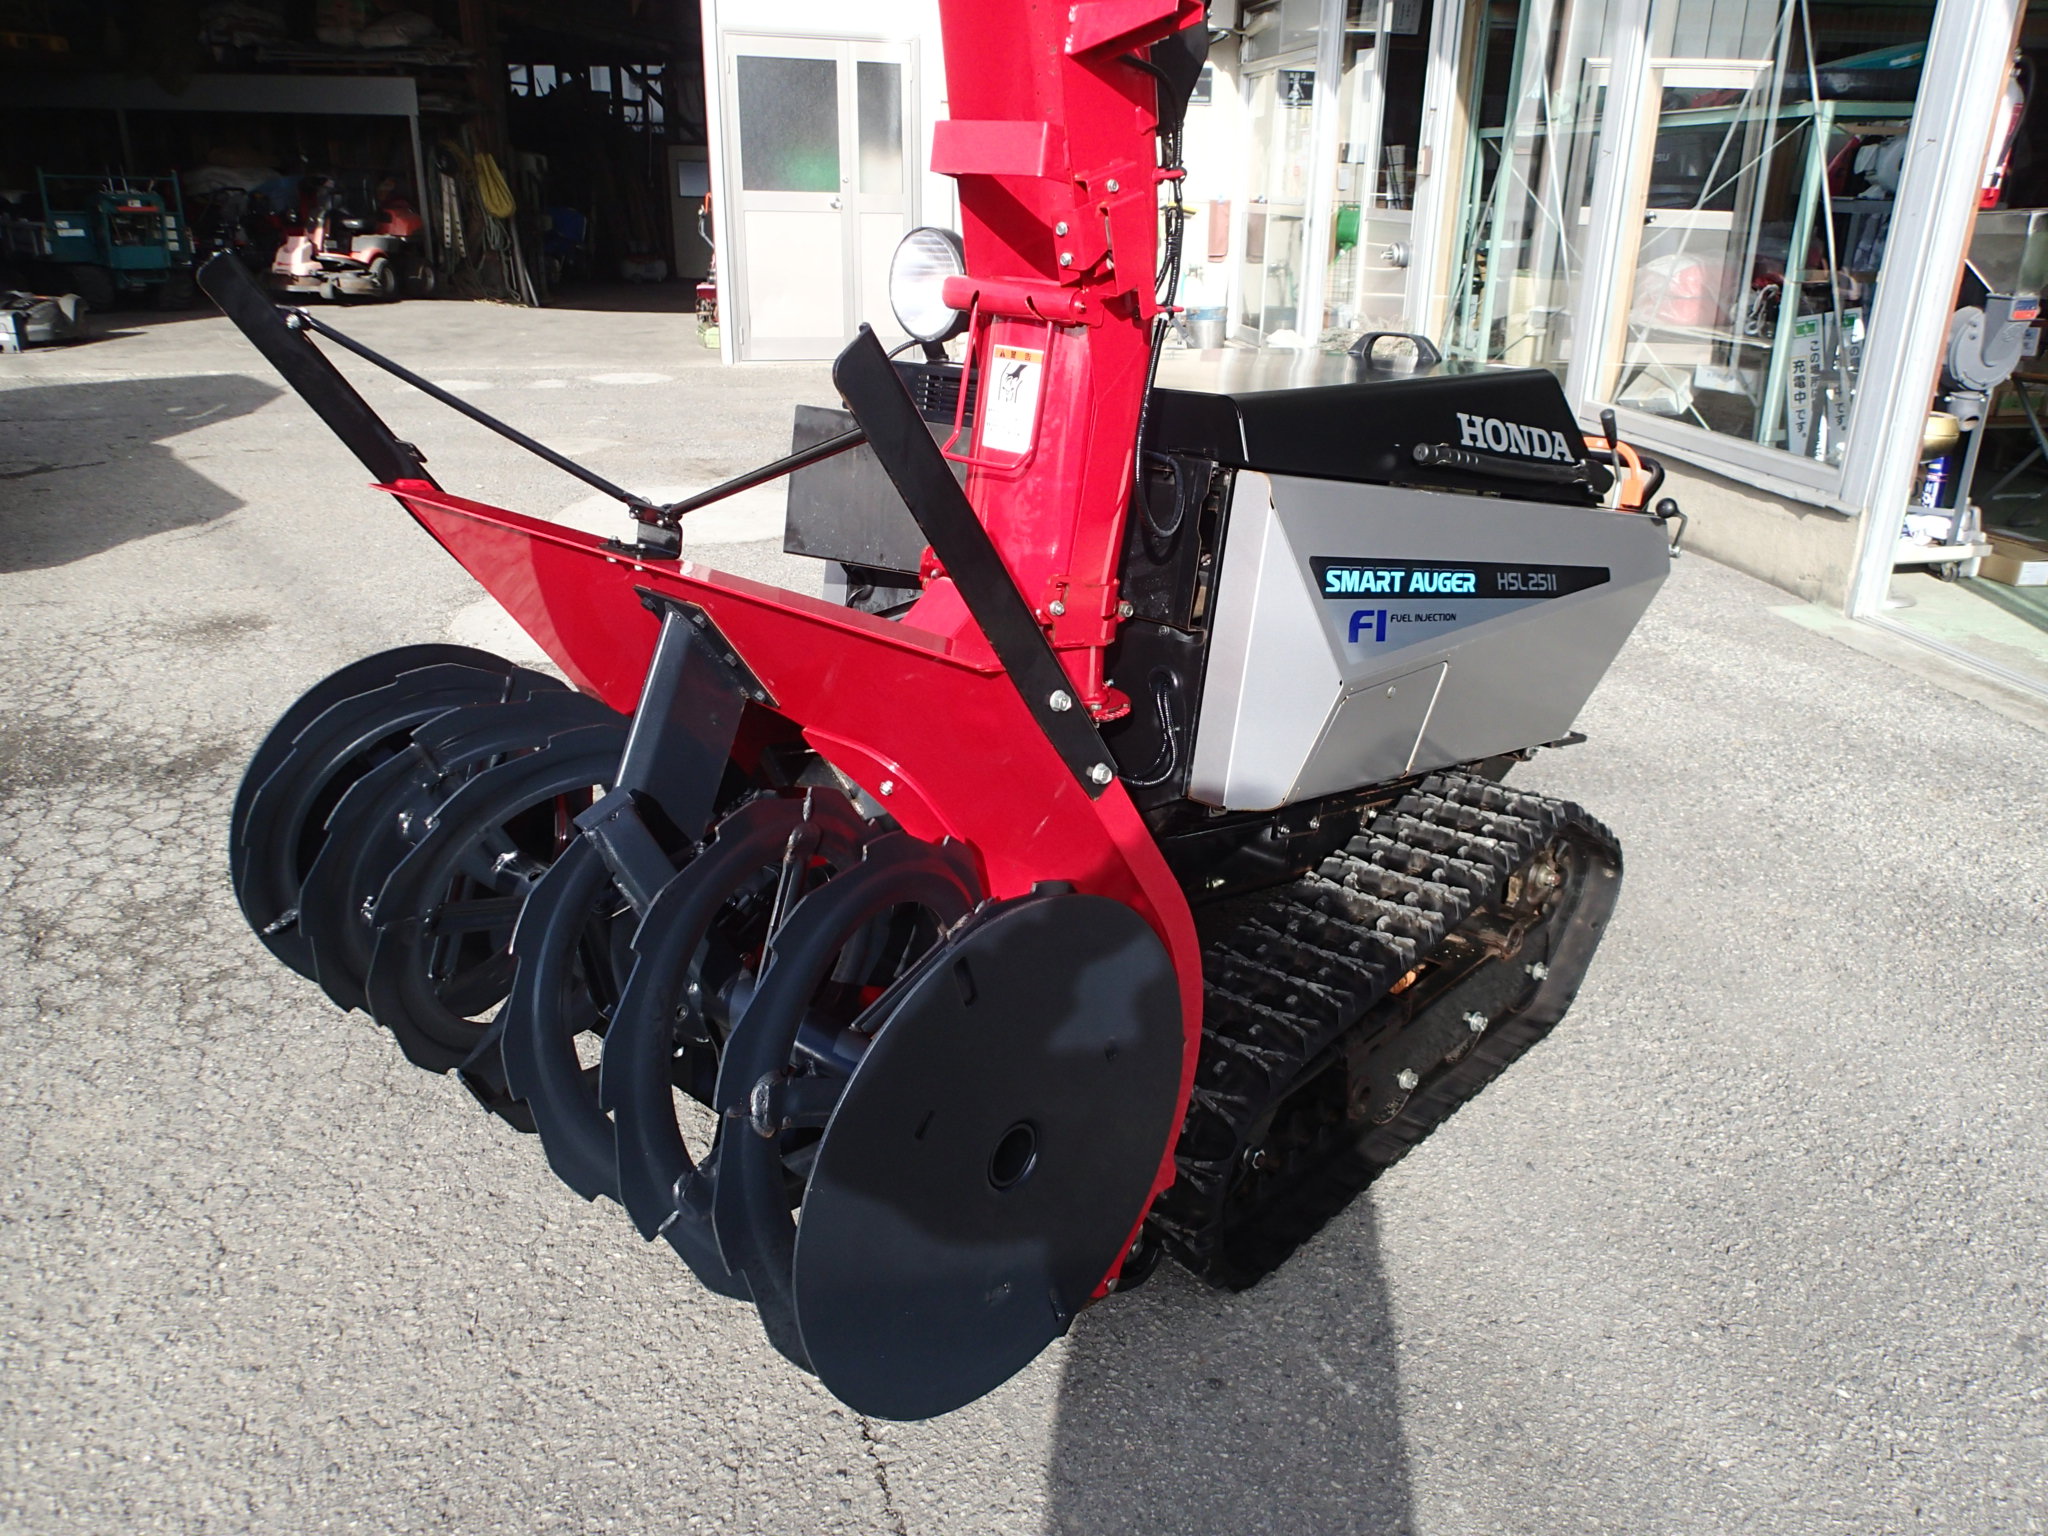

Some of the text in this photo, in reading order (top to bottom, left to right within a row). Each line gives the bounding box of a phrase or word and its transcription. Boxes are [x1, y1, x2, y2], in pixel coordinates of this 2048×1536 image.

[1456, 412, 1575, 463] HONDA
[1325, 568, 1405, 593] SMART
[1409, 569, 1476, 594] AUGER
[1348, 609, 1457, 644] FI FUEL INJECTION
